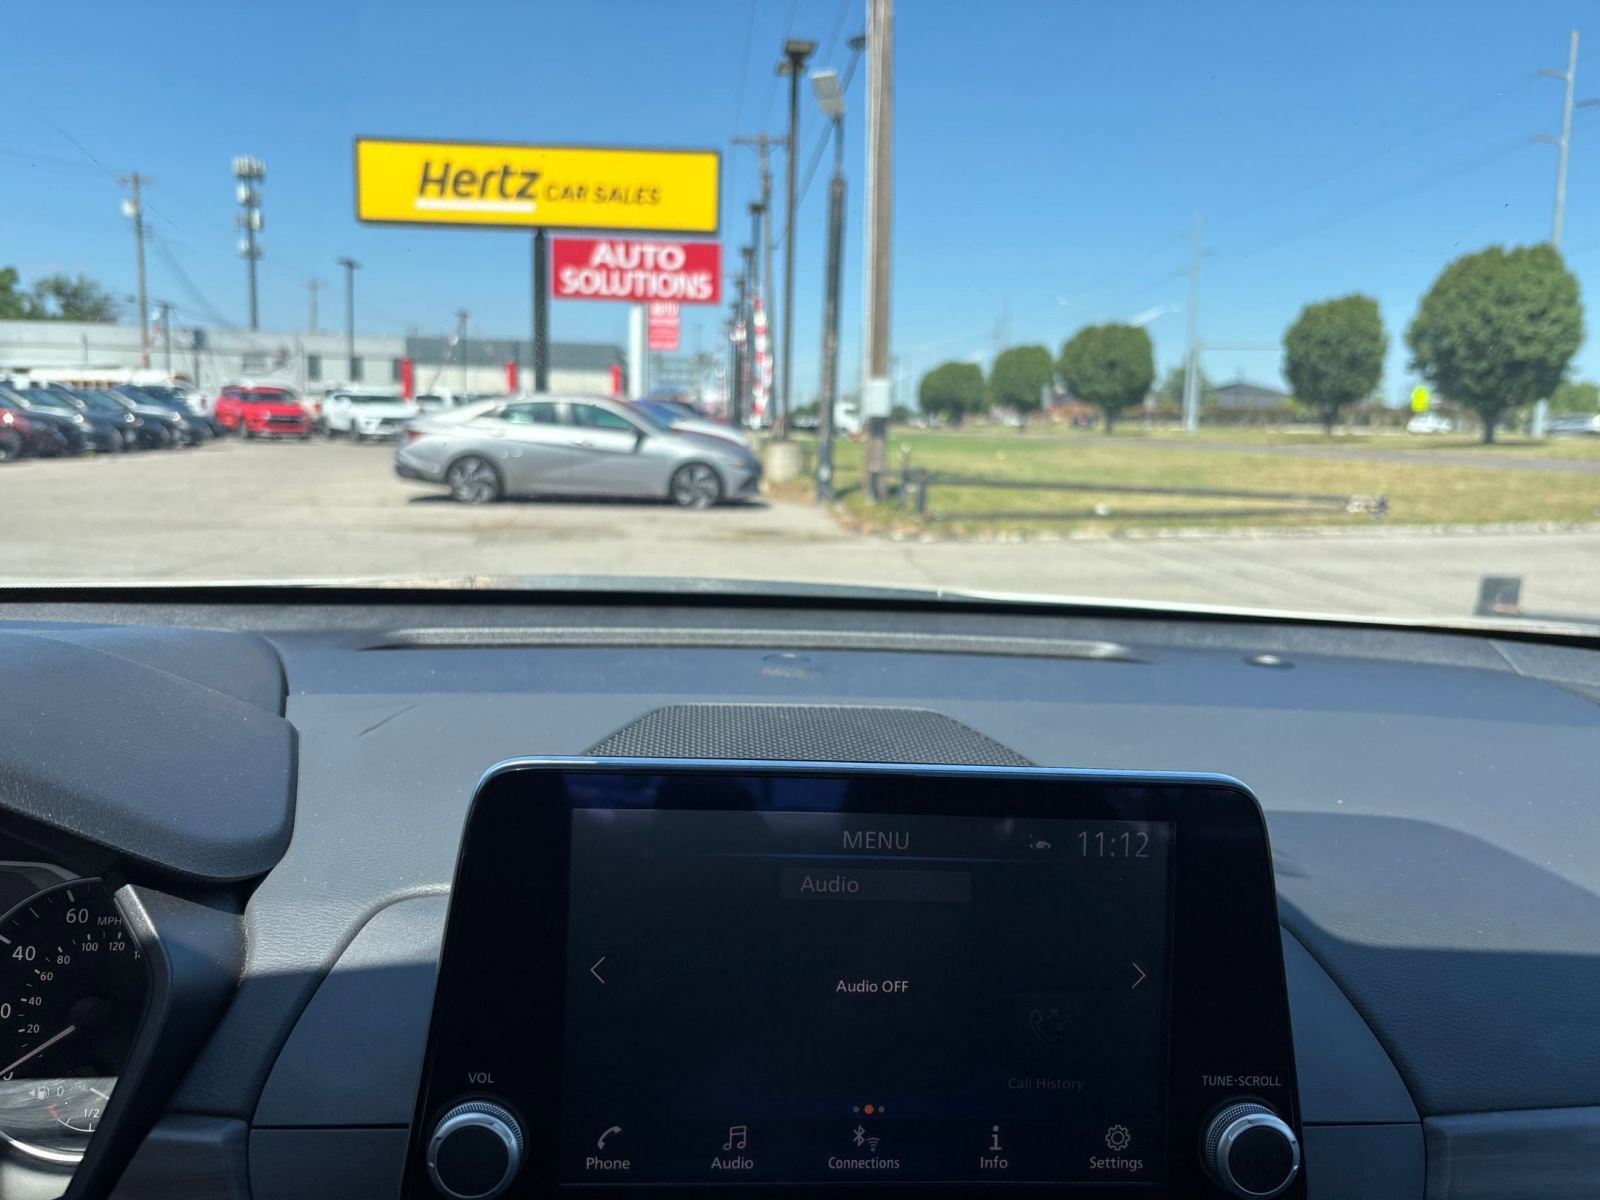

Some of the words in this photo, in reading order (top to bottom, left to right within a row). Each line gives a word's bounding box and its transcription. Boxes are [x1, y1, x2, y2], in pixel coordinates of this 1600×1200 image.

[418, 161, 540, 199] Hertz
[544, 184, 589, 203] CAR
[593, 185, 662, 206] SALES
[590, 242, 687, 271] AUTO
[559, 266, 714, 299] SOLUTIONS
[842, 831, 910, 850] MENU
[1078, 831, 1150, 858] 11:12
[800, 875, 859, 894] Audio
[66, 908, 89, 923] 60
[97, 916, 122, 926] MPH
[12, 945, 36, 961] 40
[81, 942, 99, 952] 100
[109, 941, 125, 951] 120
[57, 955, 71, 965] 80
[40, 971, 53, 982] 60
[836, 979, 878, 993] Audio
[882, 980, 909, 993] OFF
[28, 996, 42, 1006] 40
[26, 1024, 40, 1033] 20
[468, 1072, 495, 1084] VOL
[1007, 1076, 1032, 1089] Call
[1036, 1077, 1085, 1092] History
[83, 1108, 100, 1118] 1/2
[585, 1156, 631, 1171] Phone
[711, 1156, 754, 1170] Audio
[828, 1155, 900, 1170] Connections
[979, 1155, 1009, 1170] Info
[1089, 1155, 1144, 1173] Settings
